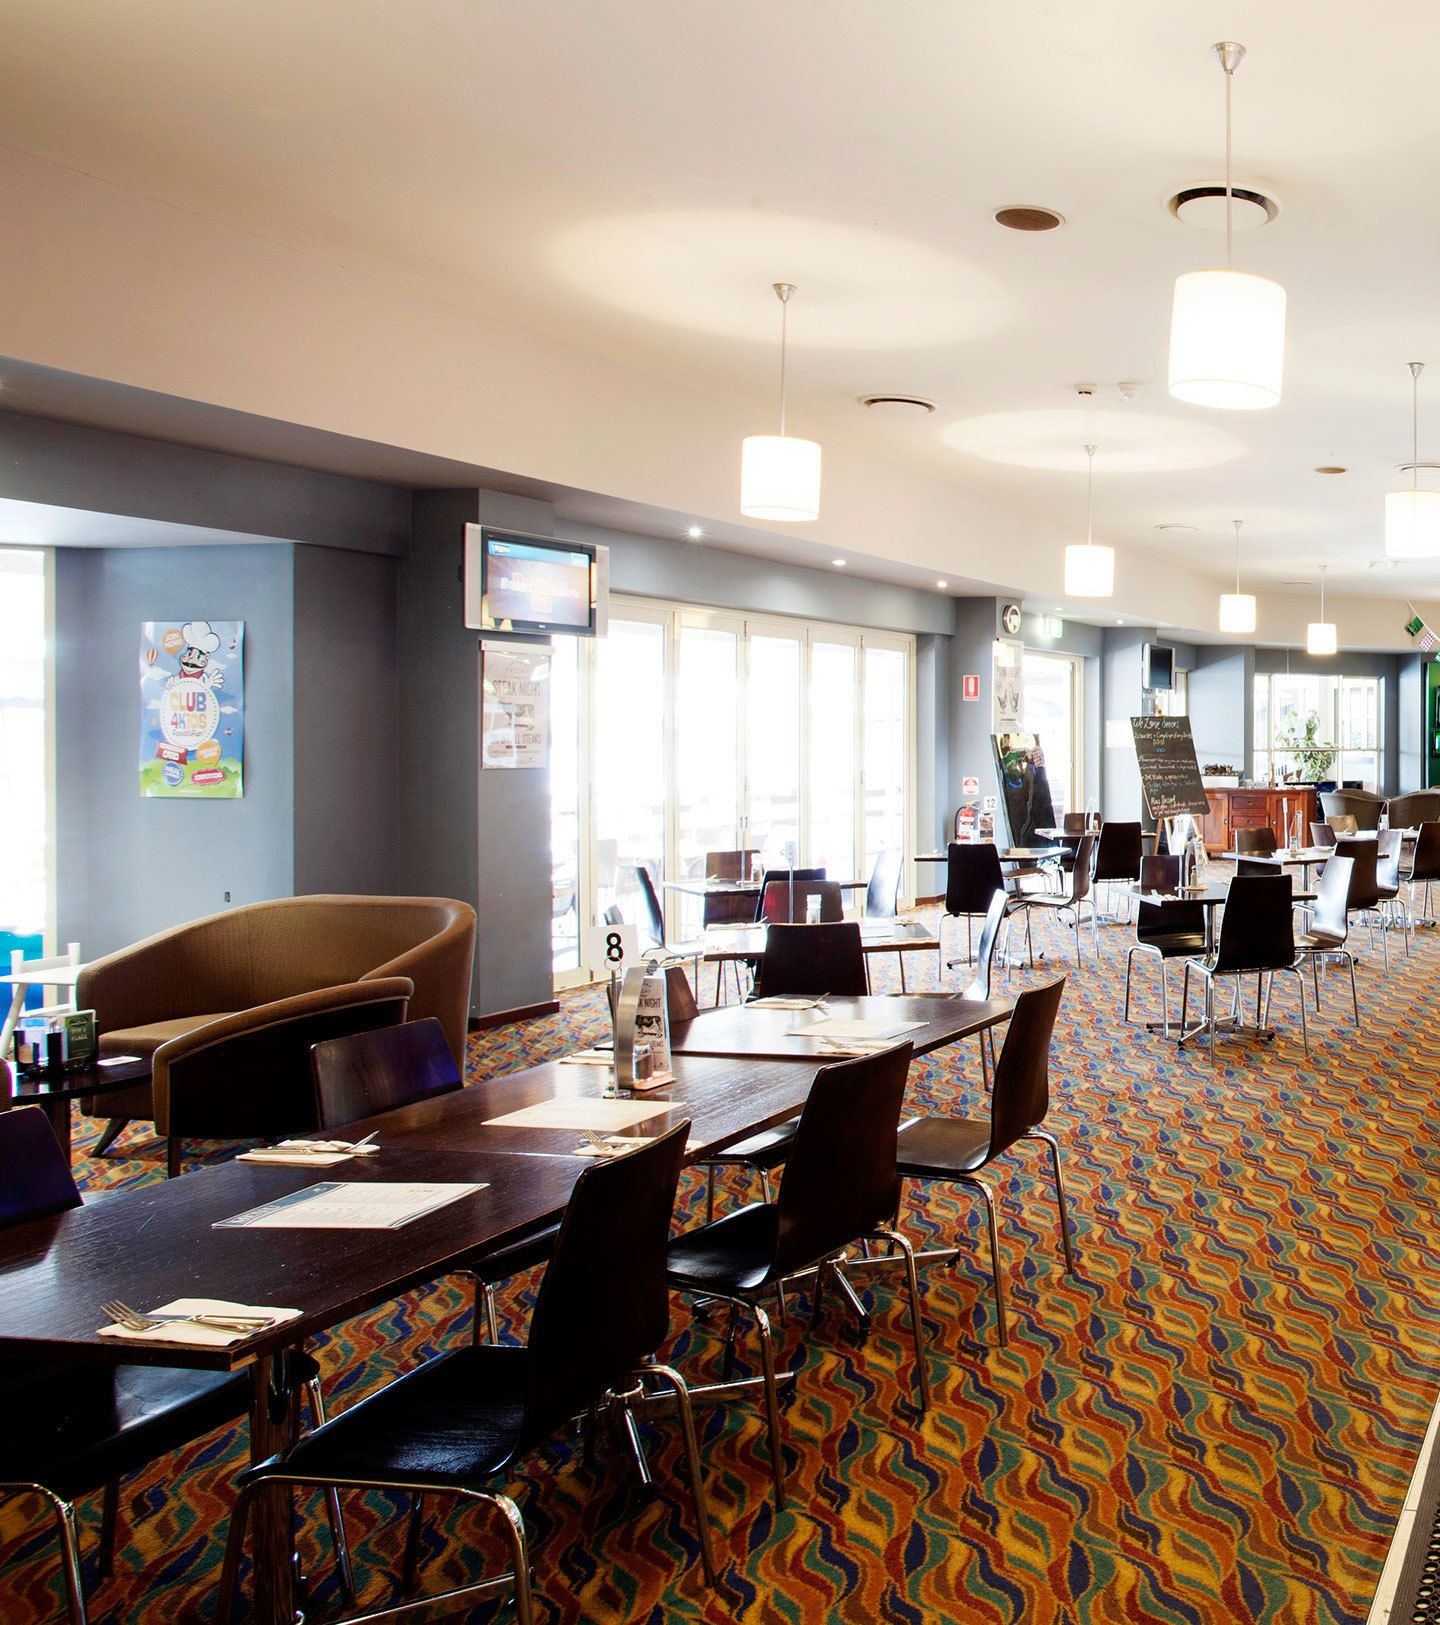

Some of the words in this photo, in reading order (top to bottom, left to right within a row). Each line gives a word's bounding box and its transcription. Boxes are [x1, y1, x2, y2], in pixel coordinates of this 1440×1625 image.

[492, 680, 517, 696] STEAK
[519, 680, 541, 697] NIGHT
[170, 692, 207, 712] CLUB
[986, 799, 996, 809] 12
[606, 932, 624, 962] 8
[644, 997, 661, 1008] NIGHT
